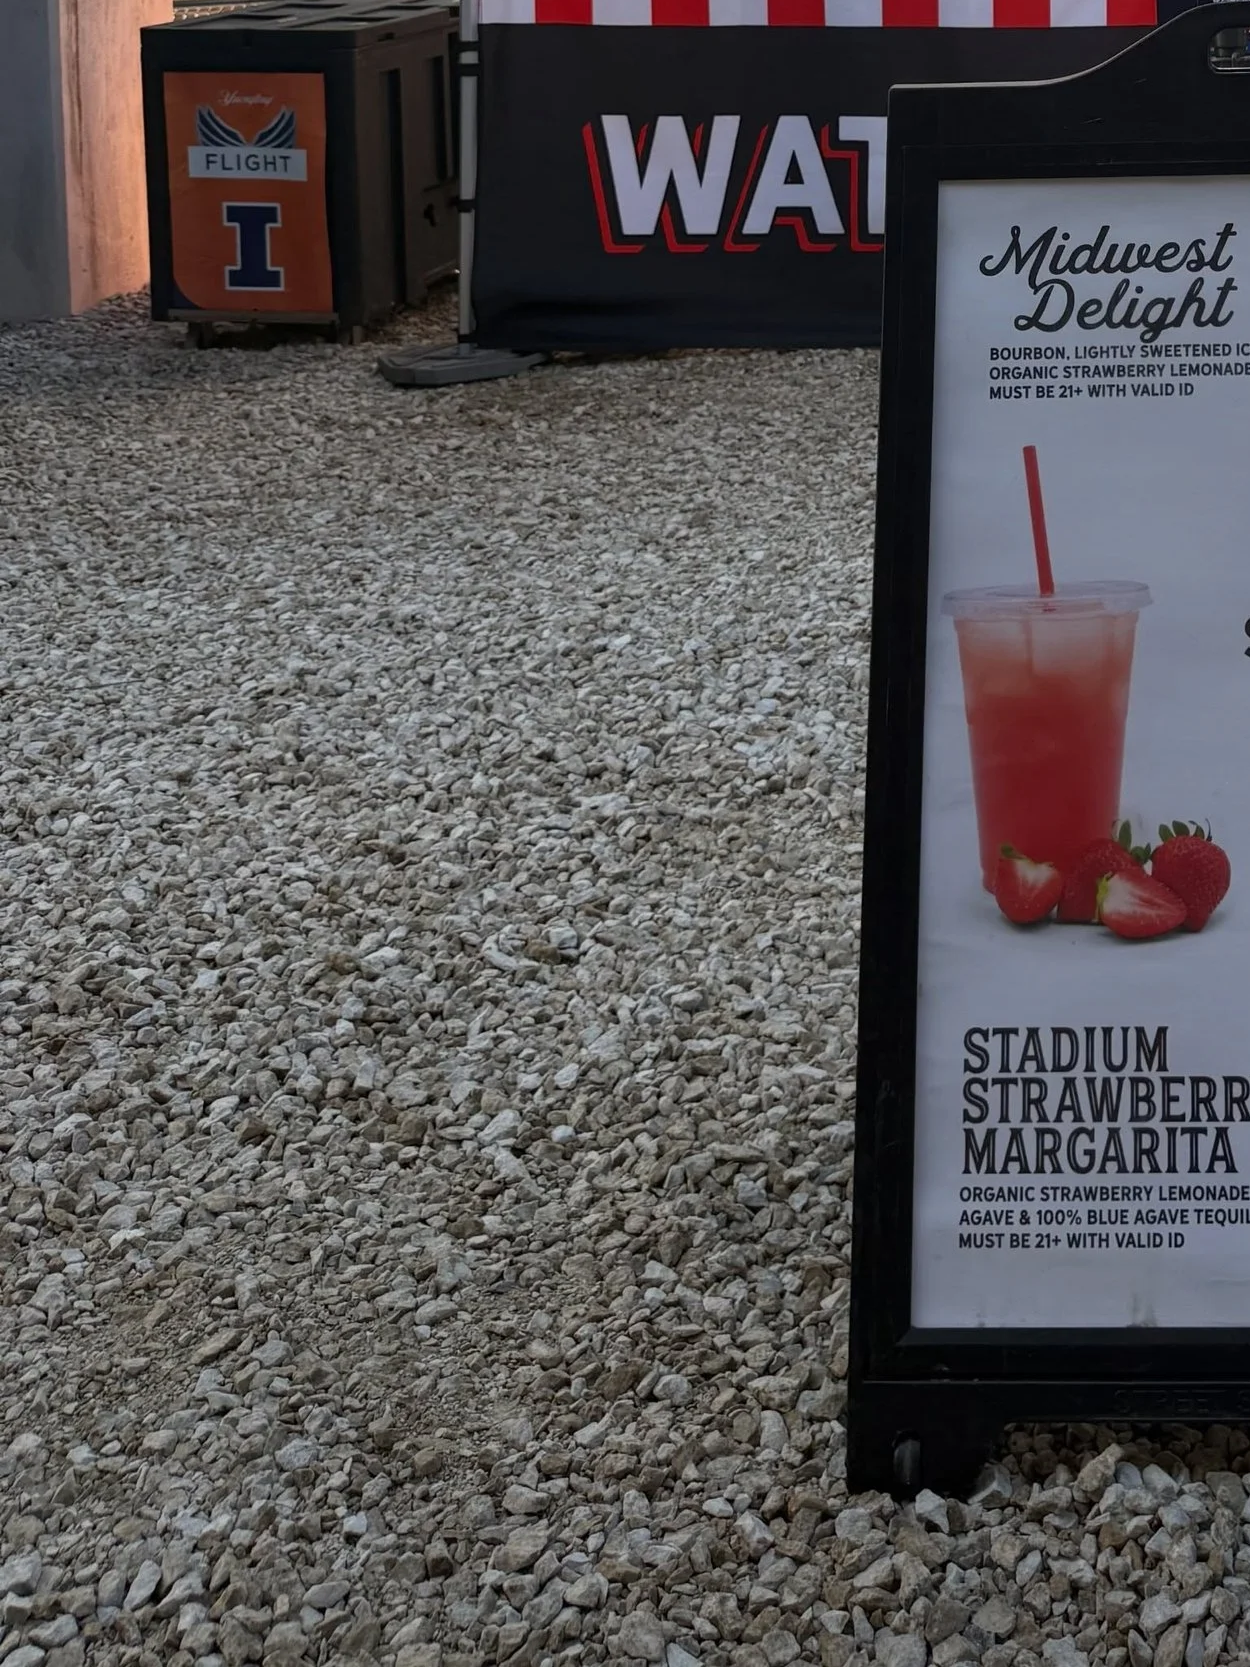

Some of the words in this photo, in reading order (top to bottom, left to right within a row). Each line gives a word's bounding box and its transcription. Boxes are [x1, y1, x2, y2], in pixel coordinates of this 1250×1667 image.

[205, 154, 292, 173] FLIGHT
[584, 114, 887, 250] WAT
[979, 222, 1238, 290] Midwest
[1013, 277, 1239, 344] Delight
[990, 346, 1070, 362] BOURBON,
[1074, 345, 1136, 360] LIGHTLY
[1140, 343, 1232, 358] SWEETENED
[989, 365, 1058, 380] ORGANIC
[1062, 364, 1166, 379] STRAWBERRY
[990, 385, 1032, 400] MUST
[1036, 385, 1055, 400] BE
[1058, 384, 1084, 399] 21+
[1087, 384, 1126, 398] WITH
[1130, 383, 1175, 397] VALID
[1179, 383, 1194, 396] ID
[963, 1026, 1169, 1074] STADIUM
[962, 1126, 1239, 1175] MARGARITA
[959, 1186, 1035, 1203] ORGANIC
[1040, 1186, 1153, 1203] STRAWBERRY
[959, 1209, 1014, 1225] AGAVE
[1019, 1209, 1031, 1225] &
[1036, 1209, 1082, 1225] 100%
[1087, 1209, 1129, 1225] BLUE
[1134, 1209, 1189, 1225] AGAVE
[959, 1232, 1004, 1249] MUST
[1009, 1232, 1030, 1249] BE
[1034, 1232, 1062, 1249] 21+
[1066, 1232, 1110, 1248] WITH
[1114, 1232, 1163, 1248] VALID
[1168, 1232, 1185, 1248] ID
